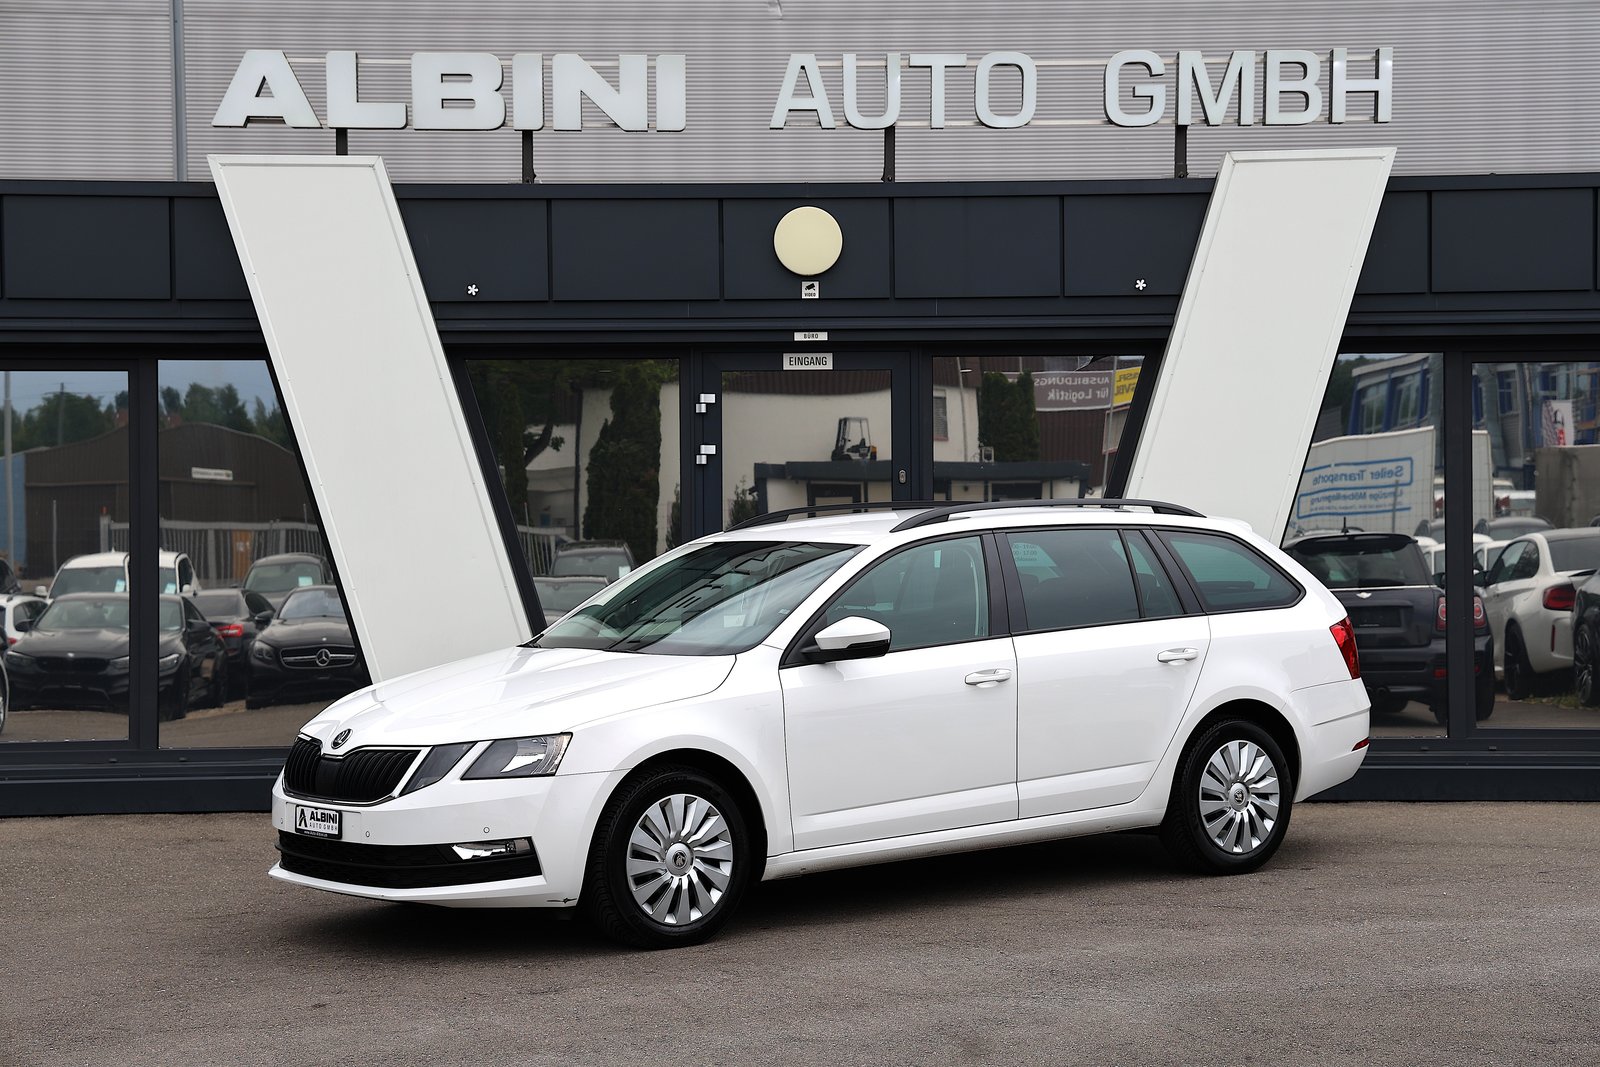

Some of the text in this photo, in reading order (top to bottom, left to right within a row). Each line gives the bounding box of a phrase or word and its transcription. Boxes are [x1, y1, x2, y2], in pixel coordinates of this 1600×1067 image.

[211, 47, 1394, 132] ALBINI AUTO GMBH
[789, 356, 828, 366] EINGANG
[309, 811, 338, 824] ALBINI
